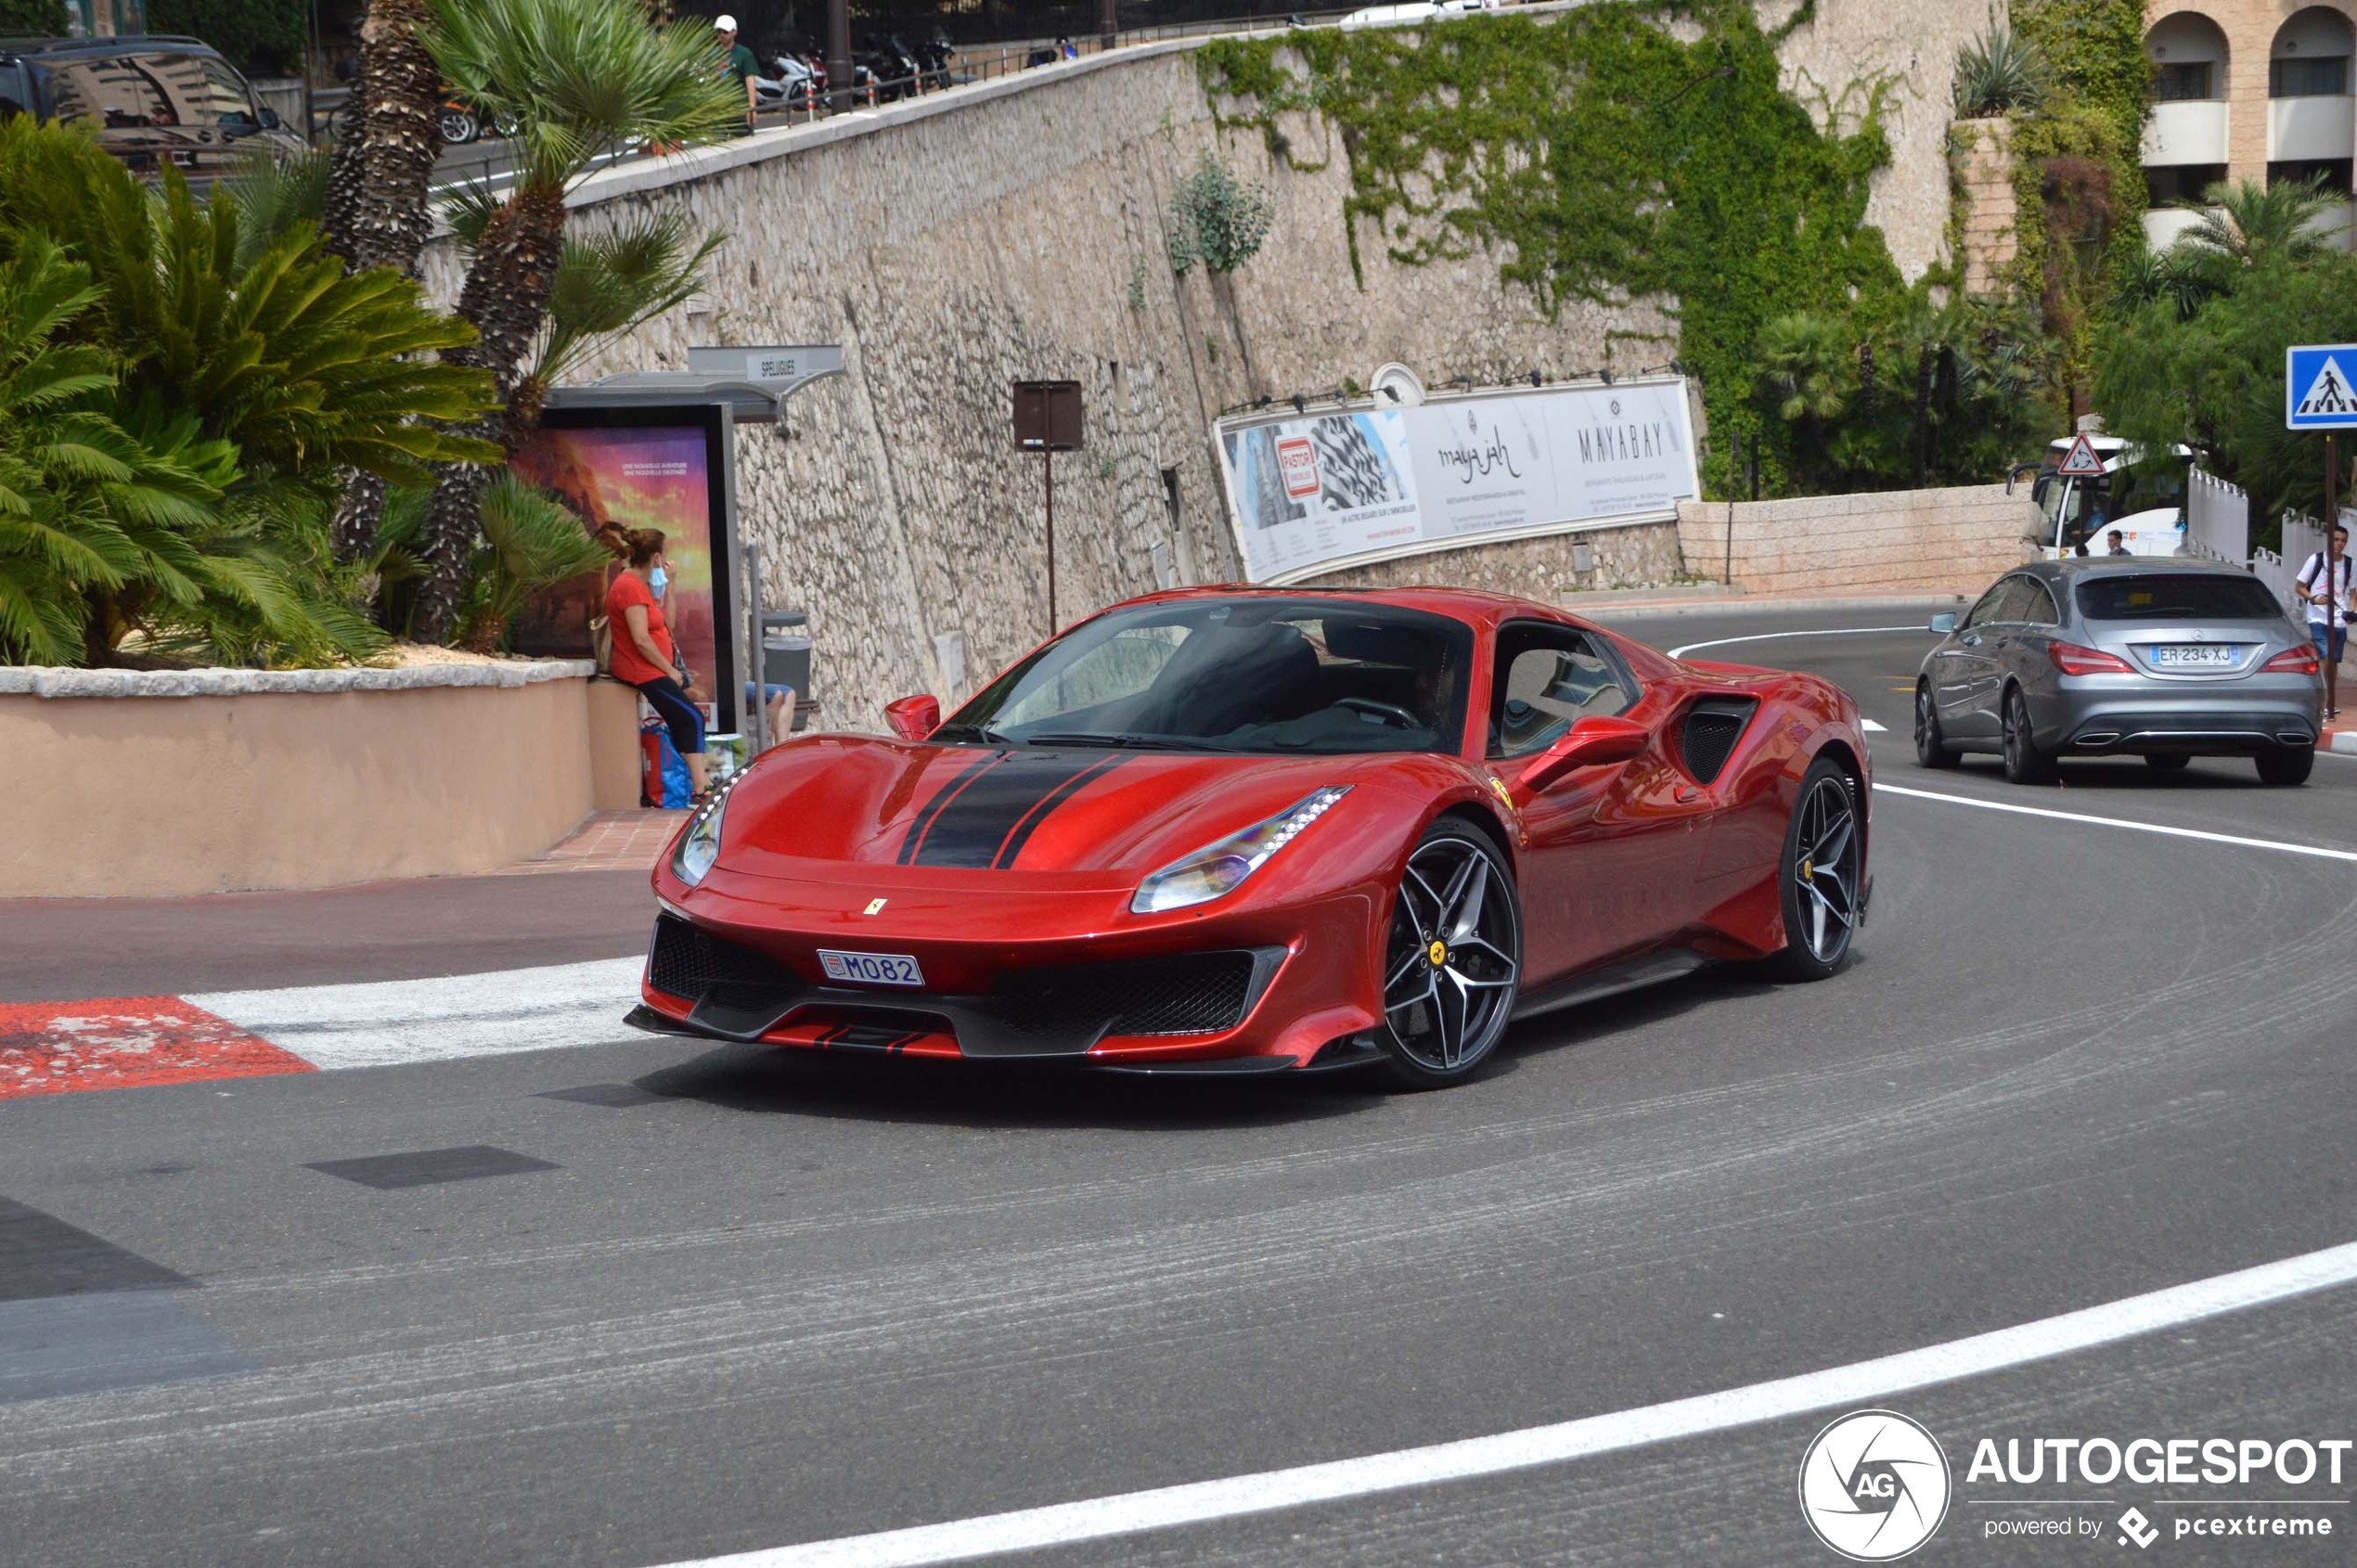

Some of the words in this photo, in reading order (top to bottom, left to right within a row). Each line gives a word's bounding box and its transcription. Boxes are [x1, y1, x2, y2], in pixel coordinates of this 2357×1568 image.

[761, 356, 795, 378] SPÉLUGUES
[1578, 422, 1662, 464] MAYABAY
[1282, 452, 1311, 468] PASTOR
[2160, 648, 2231, 662] ER-234-XJ
[843, 956, 918, 982] M082
